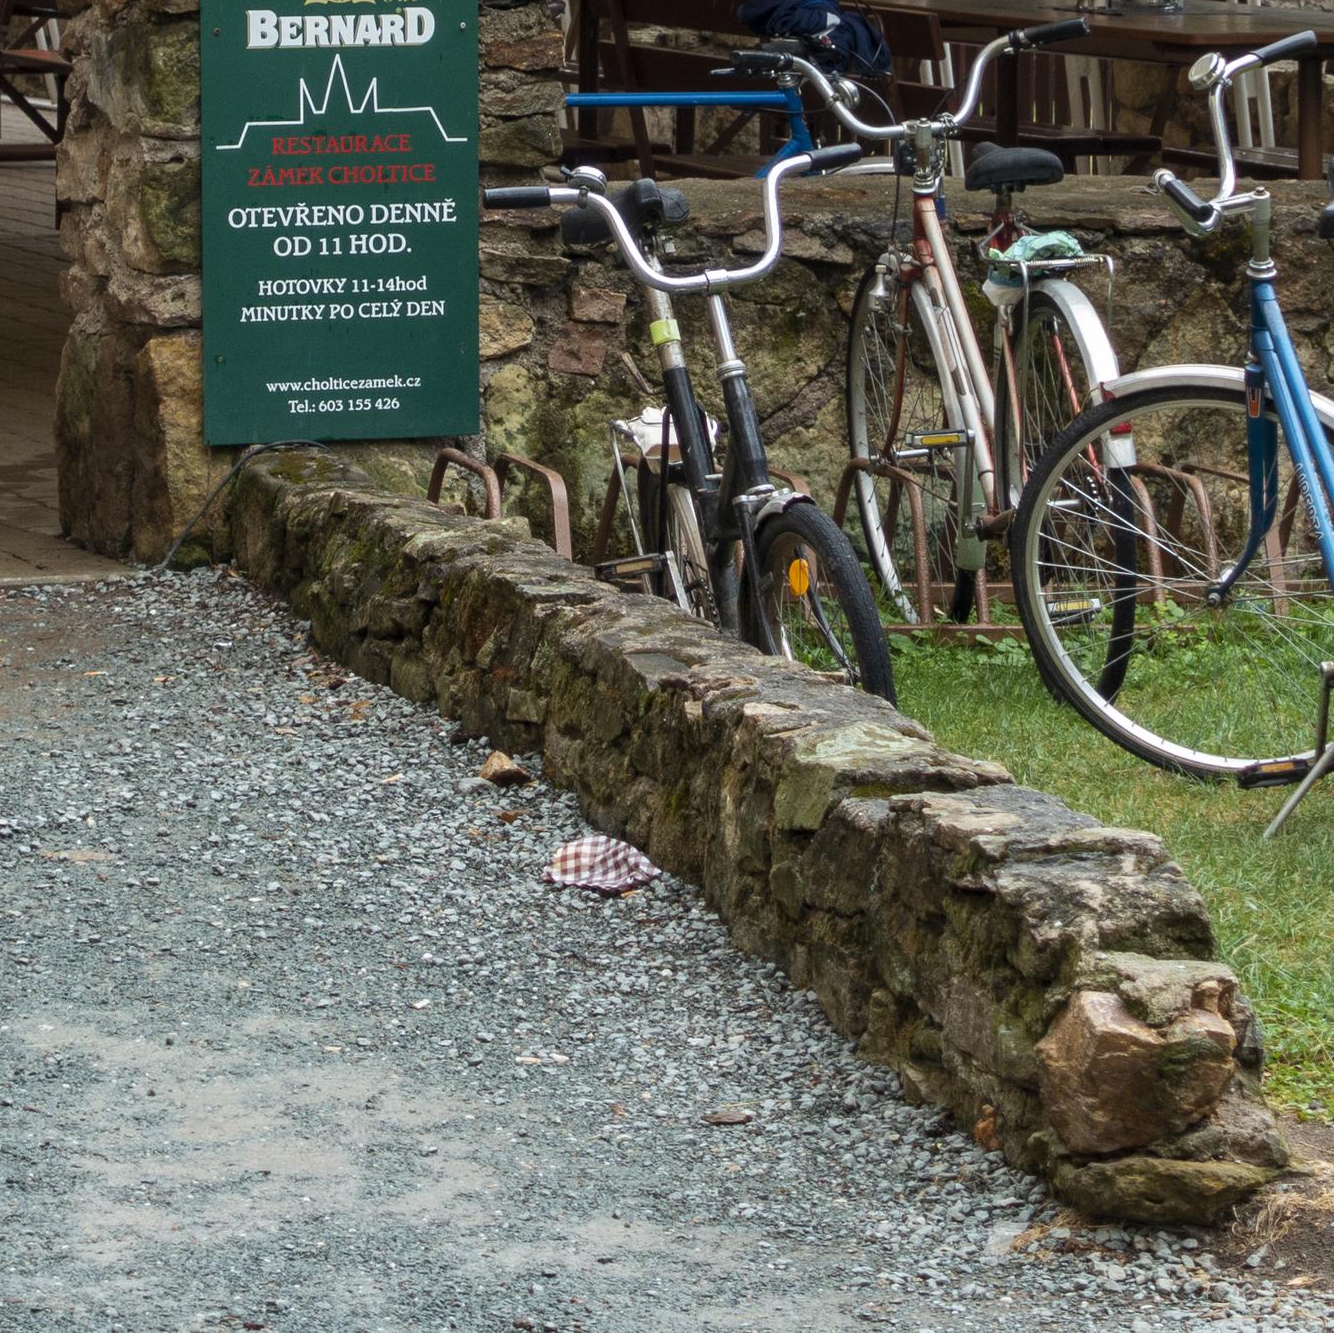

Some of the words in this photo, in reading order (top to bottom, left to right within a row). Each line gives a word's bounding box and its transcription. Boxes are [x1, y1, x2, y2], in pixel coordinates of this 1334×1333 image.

[245, 7, 436, 49] BERNARD
[272, 135, 411, 155] RESTAURACE
[248, 166, 323, 187] ZÁMEK
[328, 164, 435, 184] CHOLTICE
[228, 203, 364, 228] OTEVŘENO
[370, 199, 456, 223] DENNĚ
[274, 236, 311, 256] OD
[320, 238, 342, 255] 11
[349, 234, 411, 254] HOD.
[259, 278, 347, 295] HOTOVKY
[352, 276, 427, 292] 11-14hod
[240, 305, 325, 322] MINUTKY
[330, 304, 354, 319] PO
[359, 299, 402, 318] CELÝ
[407, 301, 445, 316] DEN
[266, 375, 421, 392] www.cholticezamek.cz
[288, 400, 315, 413] Tel.:
[319, 400, 343, 412] 603
[349, 399, 371, 410] 155
[375, 398, 399, 409] 426
